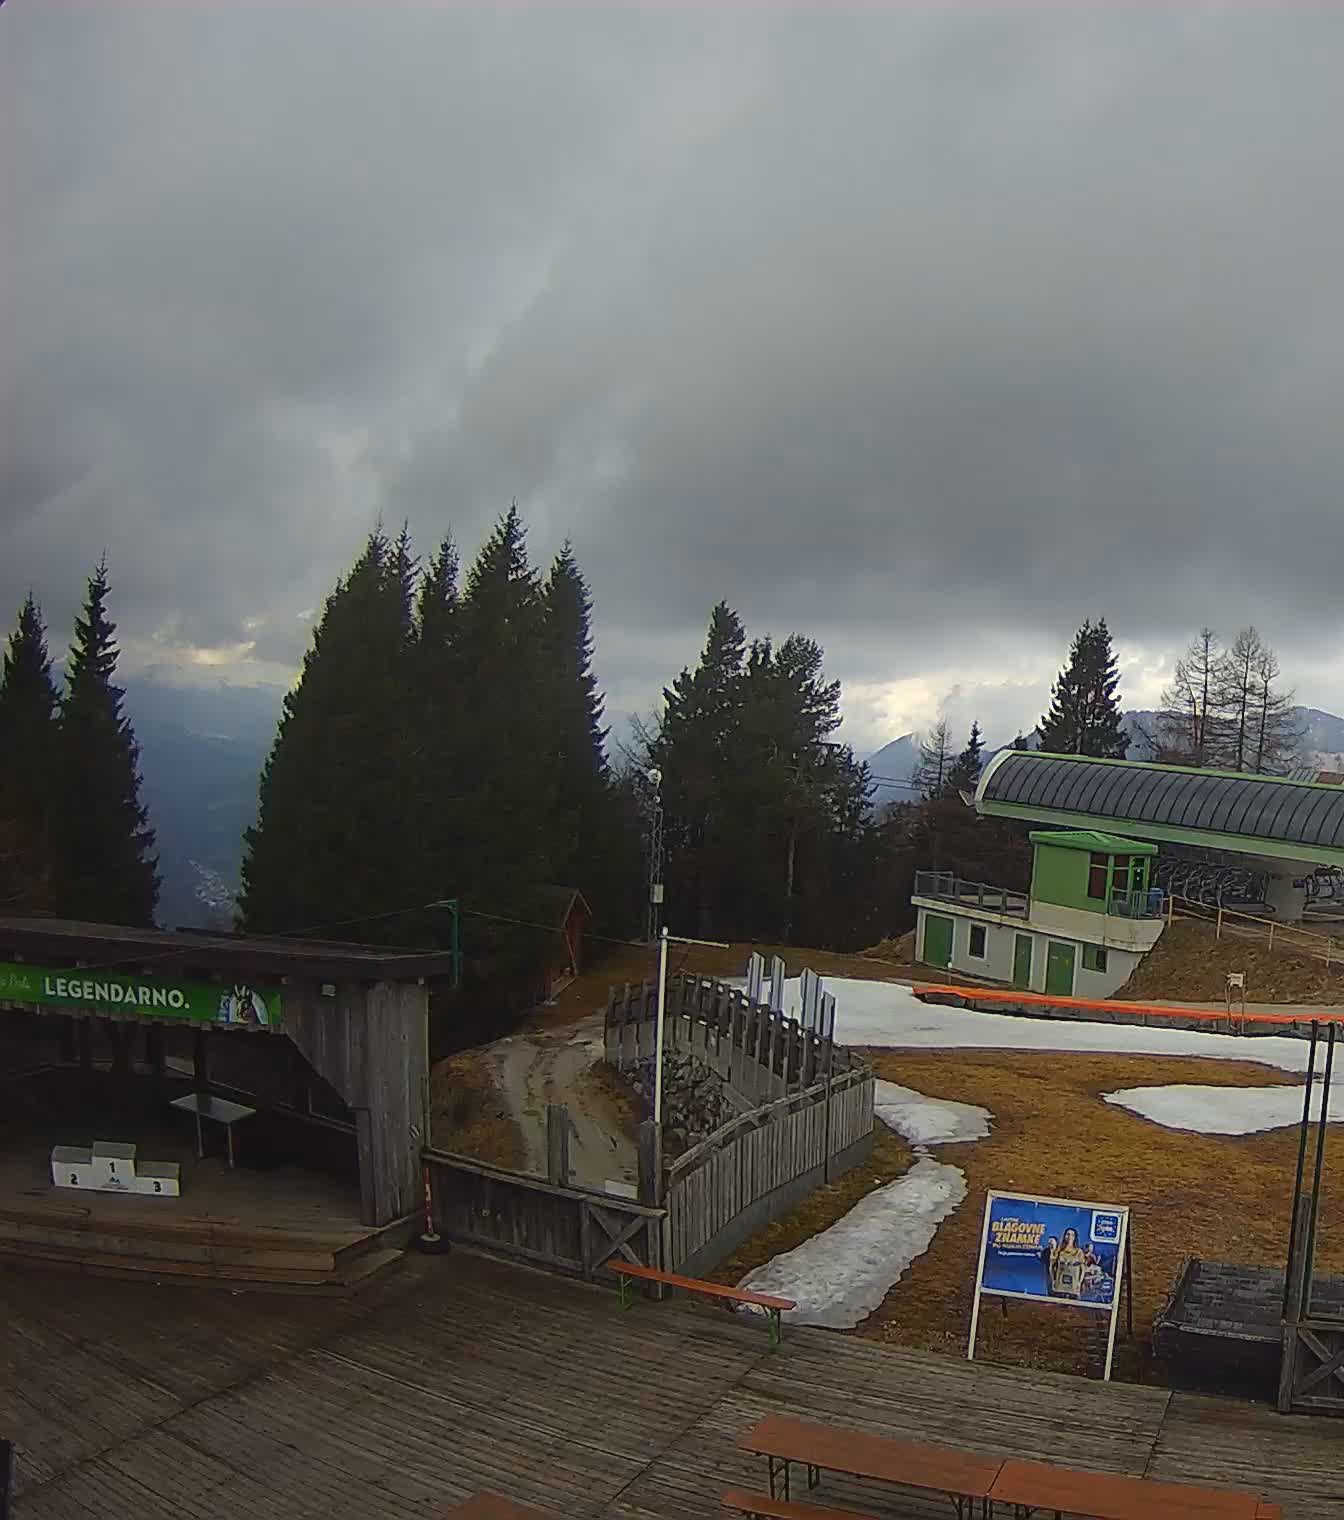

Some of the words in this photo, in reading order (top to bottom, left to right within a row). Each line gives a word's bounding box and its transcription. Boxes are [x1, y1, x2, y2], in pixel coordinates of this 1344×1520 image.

[44, 976, 191, 1009] LEGENDARNO.
[108, 1161, 117, 1174] 1
[69, 1173, 79, 1185] 2
[153, 1180, 163, 1193] 3
[992, 1221, 1046, 1234] BLAGOVNE
[995, 1232, 1041, 1244] ZNAMKE
